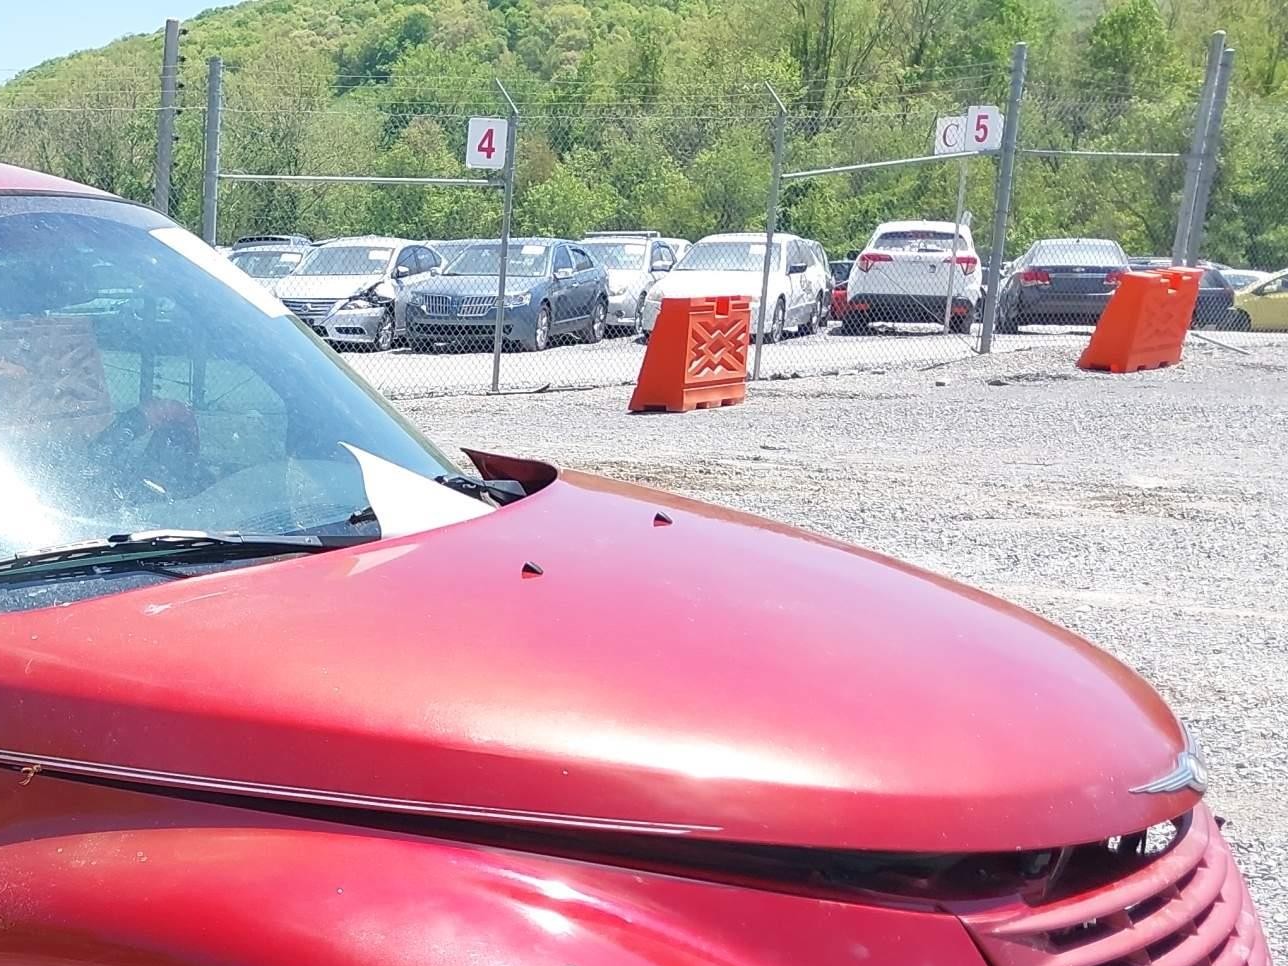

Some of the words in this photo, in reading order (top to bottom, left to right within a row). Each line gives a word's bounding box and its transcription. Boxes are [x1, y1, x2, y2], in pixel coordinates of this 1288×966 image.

[942, 123, 959, 148] C
[974, 114, 989, 143] 5
[477, 128, 496, 159] 4
